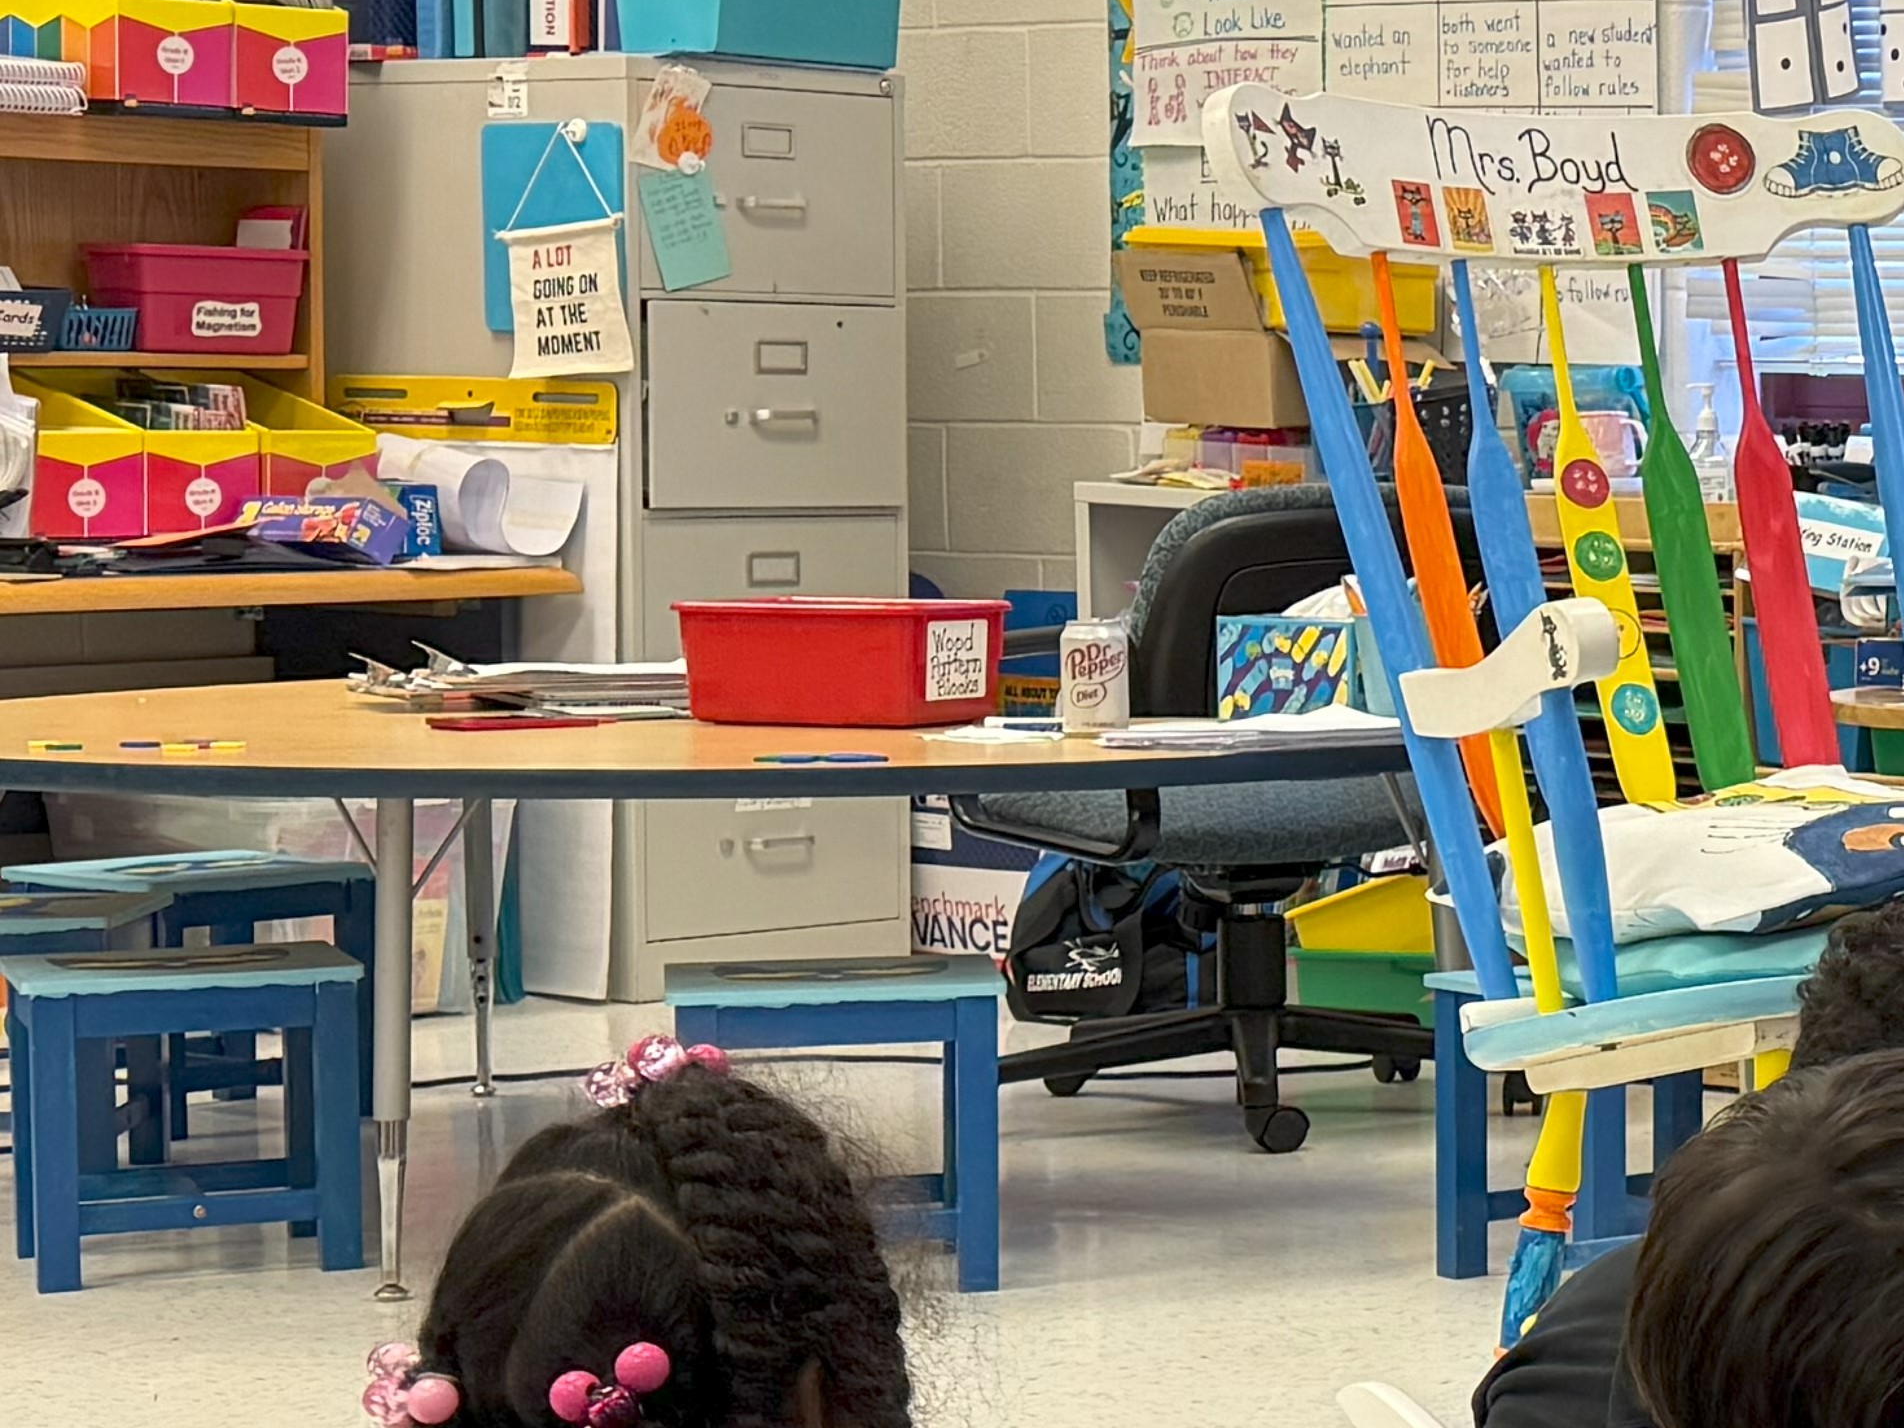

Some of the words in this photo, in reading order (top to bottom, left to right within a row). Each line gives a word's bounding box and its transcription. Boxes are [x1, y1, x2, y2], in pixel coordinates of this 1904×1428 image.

[1426, 115, 1523, 195] Mrs.
[1519, 117, 1639, 195] Boyd
[533, 250, 541, 269] A
[547, 245, 571, 267] LOT
[533, 276, 574, 300] GOING
[579, 273, 598, 294] ON
[196, 306, 237, 319] Fishing
[240, 308, 255, 317] for
[537, 307, 553, 328] AT
[560, 303, 587, 325] THE
[196, 319, 257, 332] Magnetism
[538, 331, 600, 356] MOMENT
[415, 498, 431, 545] Ziploc
[1067, 649, 1125, 680] Pepper
[1087, 644, 1114, 663] Dr
[1076, 689, 1099, 705] Diet
